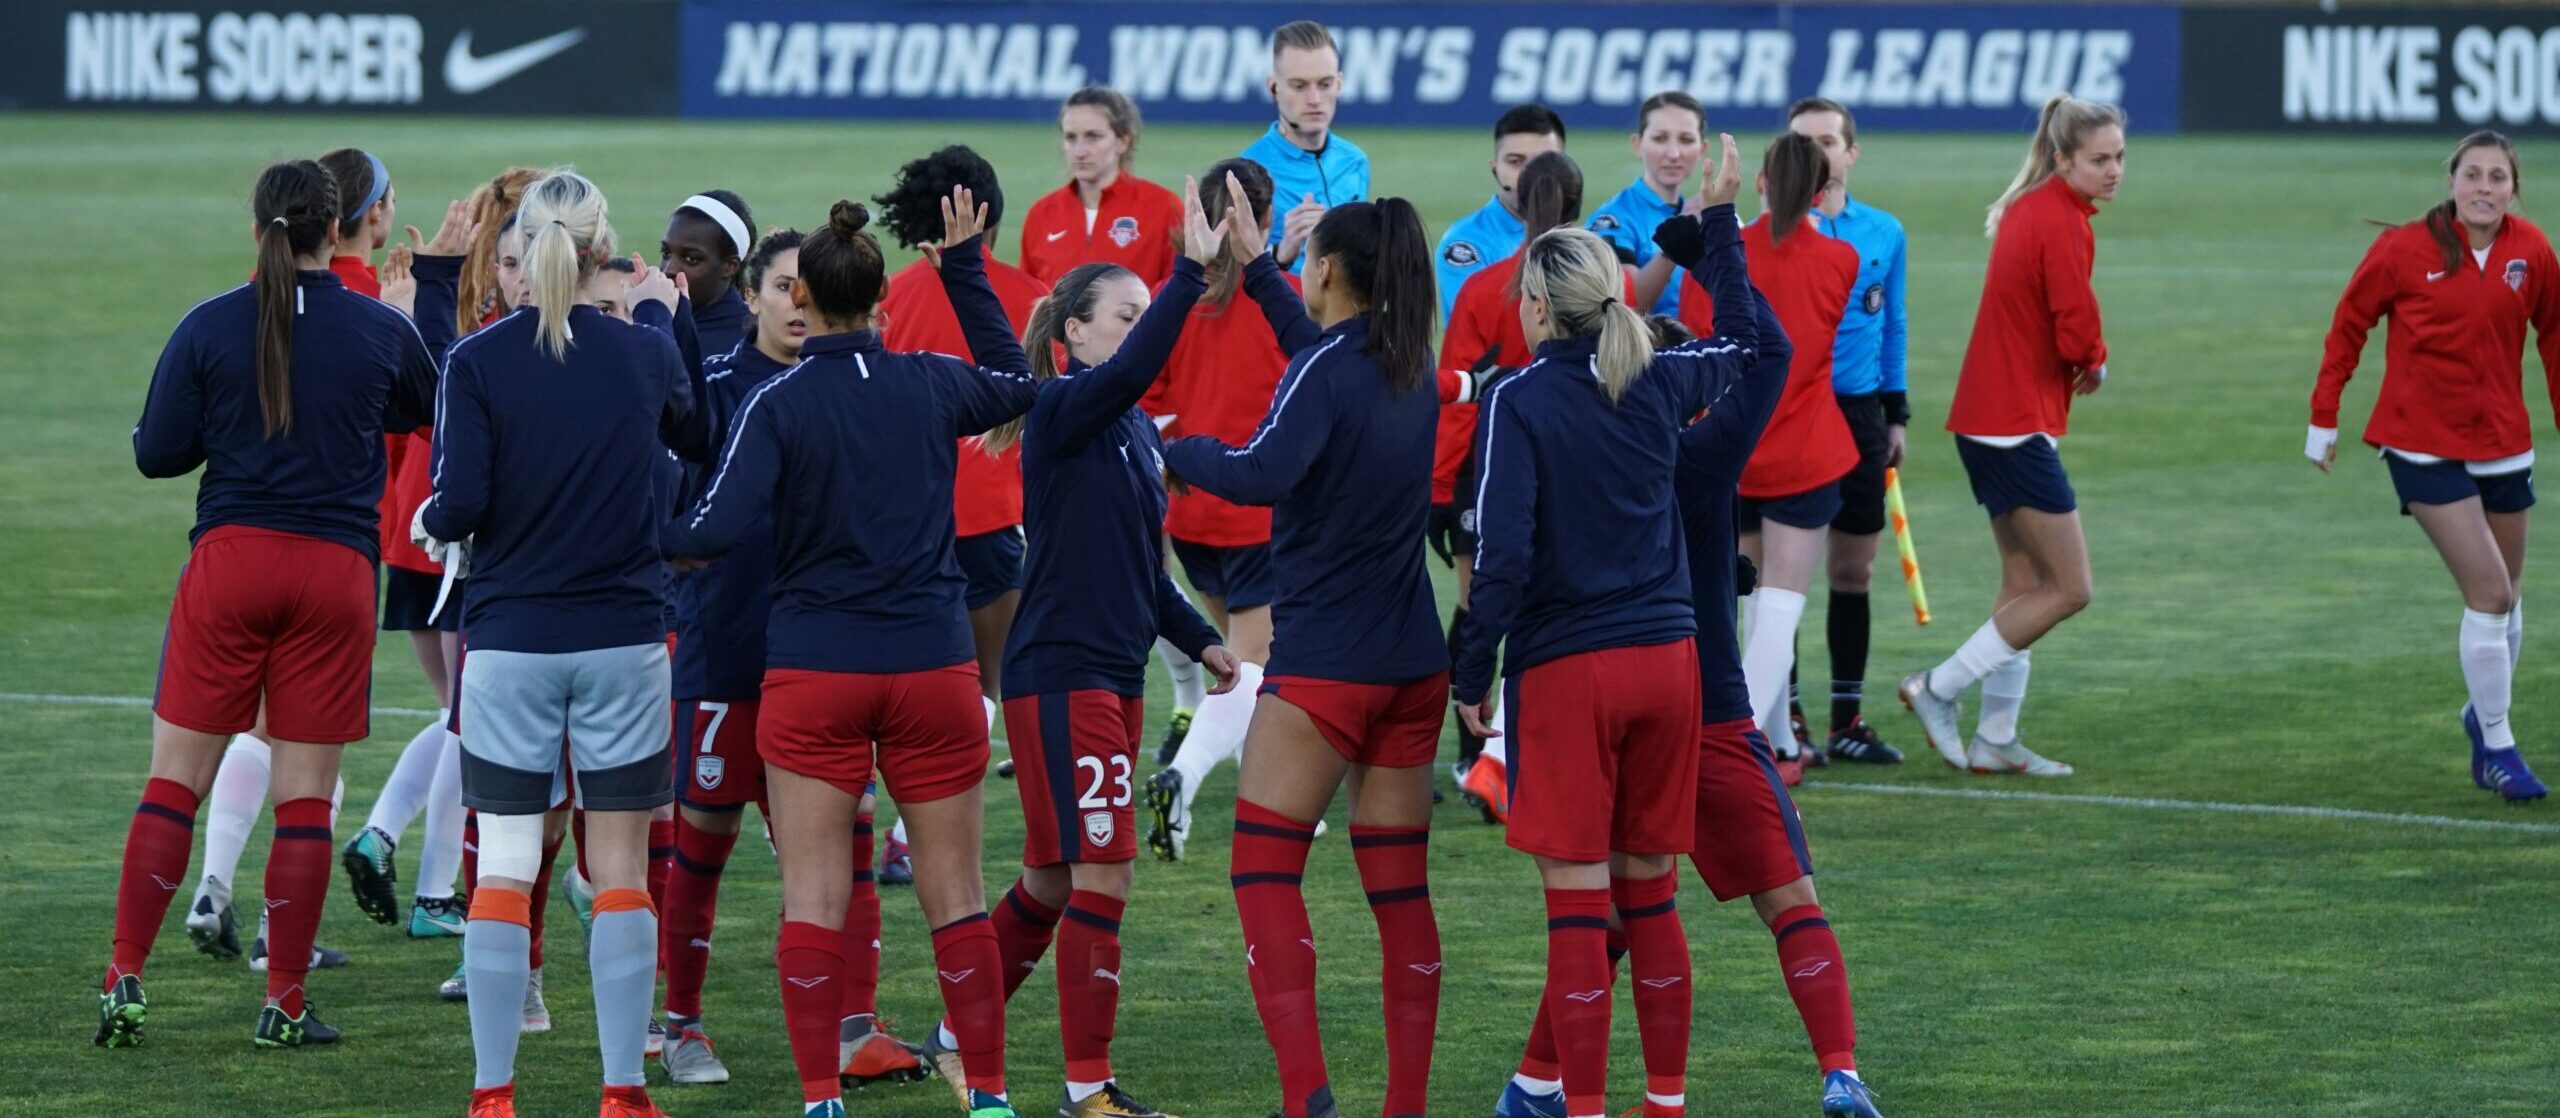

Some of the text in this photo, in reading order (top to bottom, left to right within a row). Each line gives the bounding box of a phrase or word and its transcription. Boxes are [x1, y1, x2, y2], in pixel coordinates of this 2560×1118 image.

[66, 13, 423, 101] NIKE SOCCER
[716, 23, 2131, 107] NATIONAL WOMN'S SOCCER LEAGUE
[2282, 26, 2439, 121] NIKE
[699, 701, 728, 752] 7
[1077, 754, 1132, 808] 23
